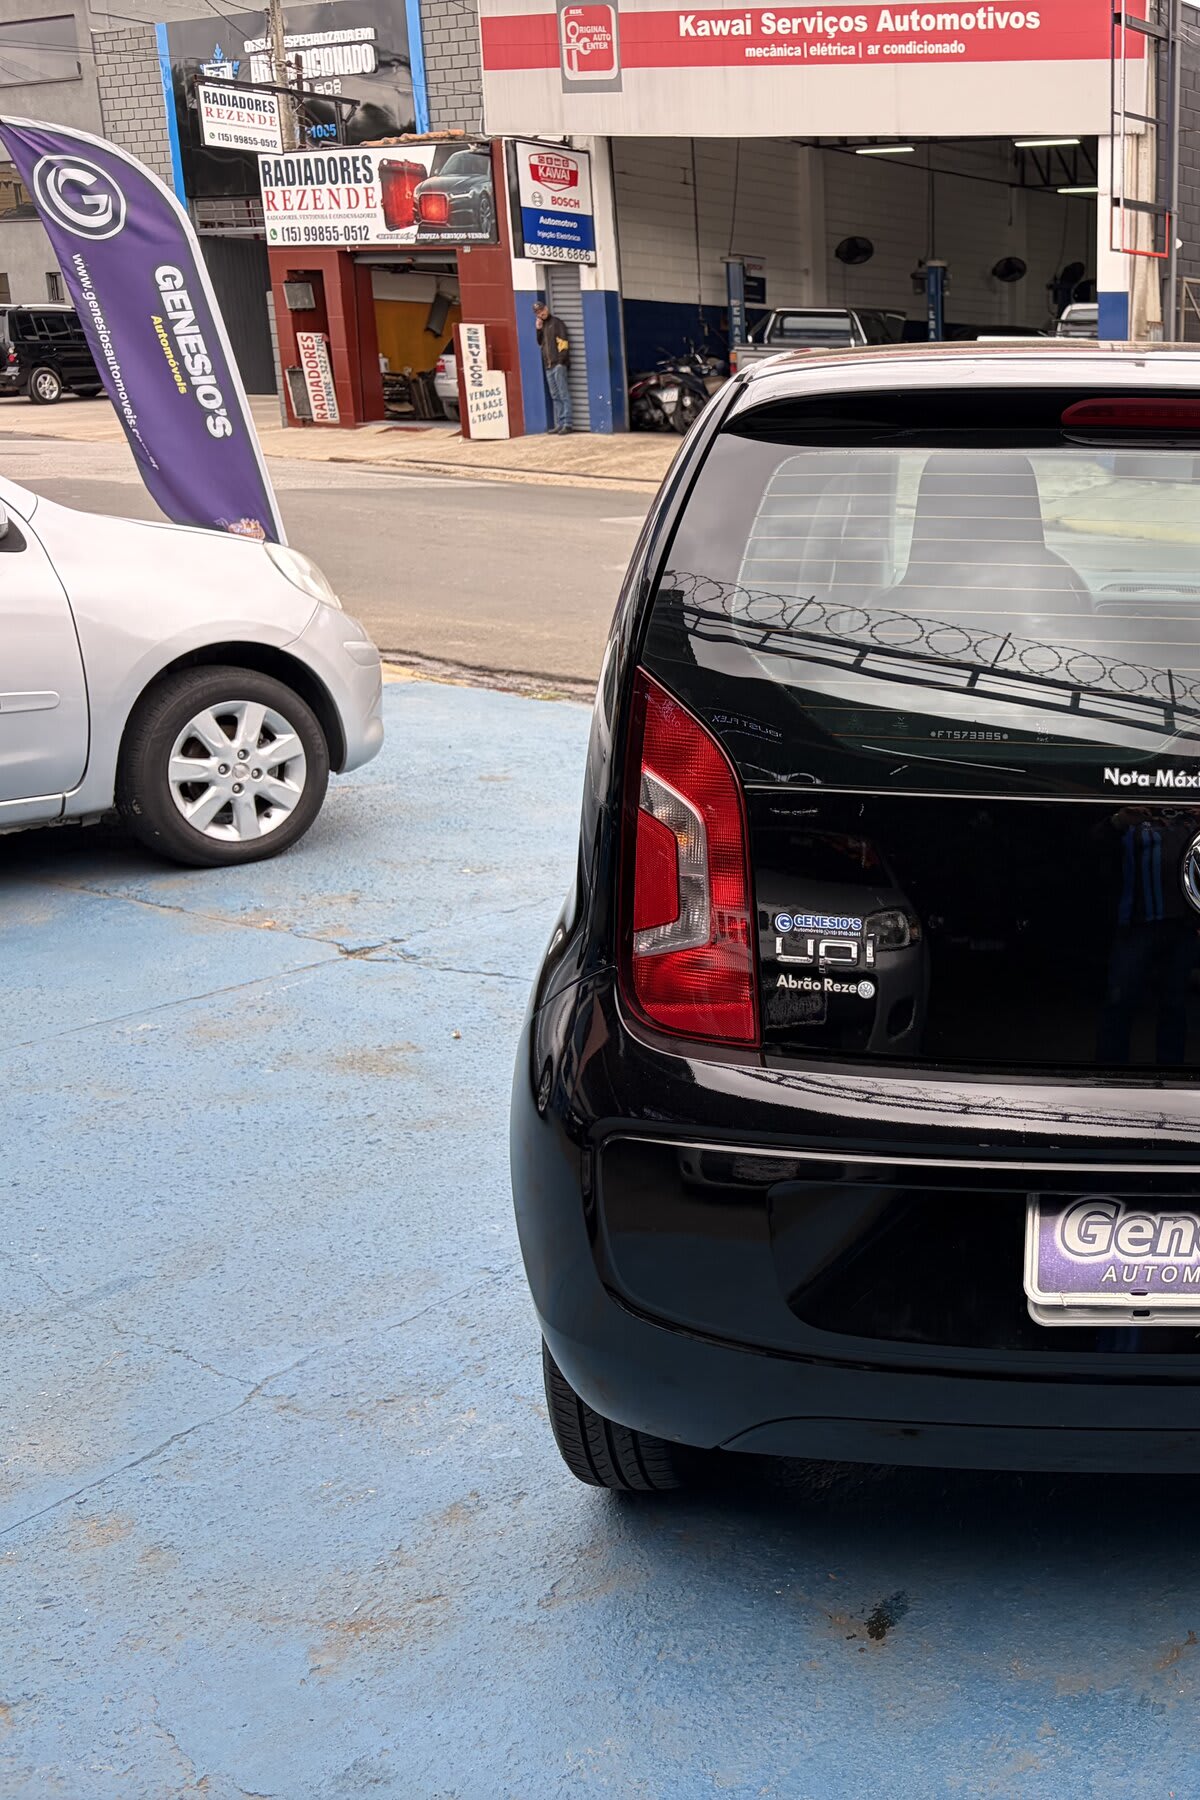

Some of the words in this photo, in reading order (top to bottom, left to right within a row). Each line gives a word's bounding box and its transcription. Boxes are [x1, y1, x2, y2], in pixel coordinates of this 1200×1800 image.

[679, 14, 752, 37] Kawai
[760, 12, 868, 39] Serviços
[876, 7, 1041, 32] Automotivos
[745, 44, 802, 58] mecânica
[809, 42, 856, 56] elétrica
[867, 45, 881, 55] ar
[883, 40, 965, 55] condicionado
[203, 91, 275, 114] RADIADORES
[205, 106, 277, 127] REZENDE
[218, 132, 232, 143] (15)
[233, 134, 278, 149] 99855-0512
[261, 155, 374, 187] RADIADORES
[538, 166, 570, 180] KAWAI
[264, 187, 377, 211] REZENDE
[551, 195, 580, 208] BOSCH
[281, 226, 300, 242] (15)
[304, 225, 370, 242] 99855-0512
[155, 265, 233, 439] GENESIO'S
[301, 335, 328, 420] RADIADORES
[469, 387, 501, 401] VENDAS
[478, 410, 504, 423] TROCA
[1103, 767, 1150, 786] Nota
[793, 914, 862, 931] GENESIO'S
[776, 974, 822, 991] Abrão
[824, 978, 857, 994] Reze
